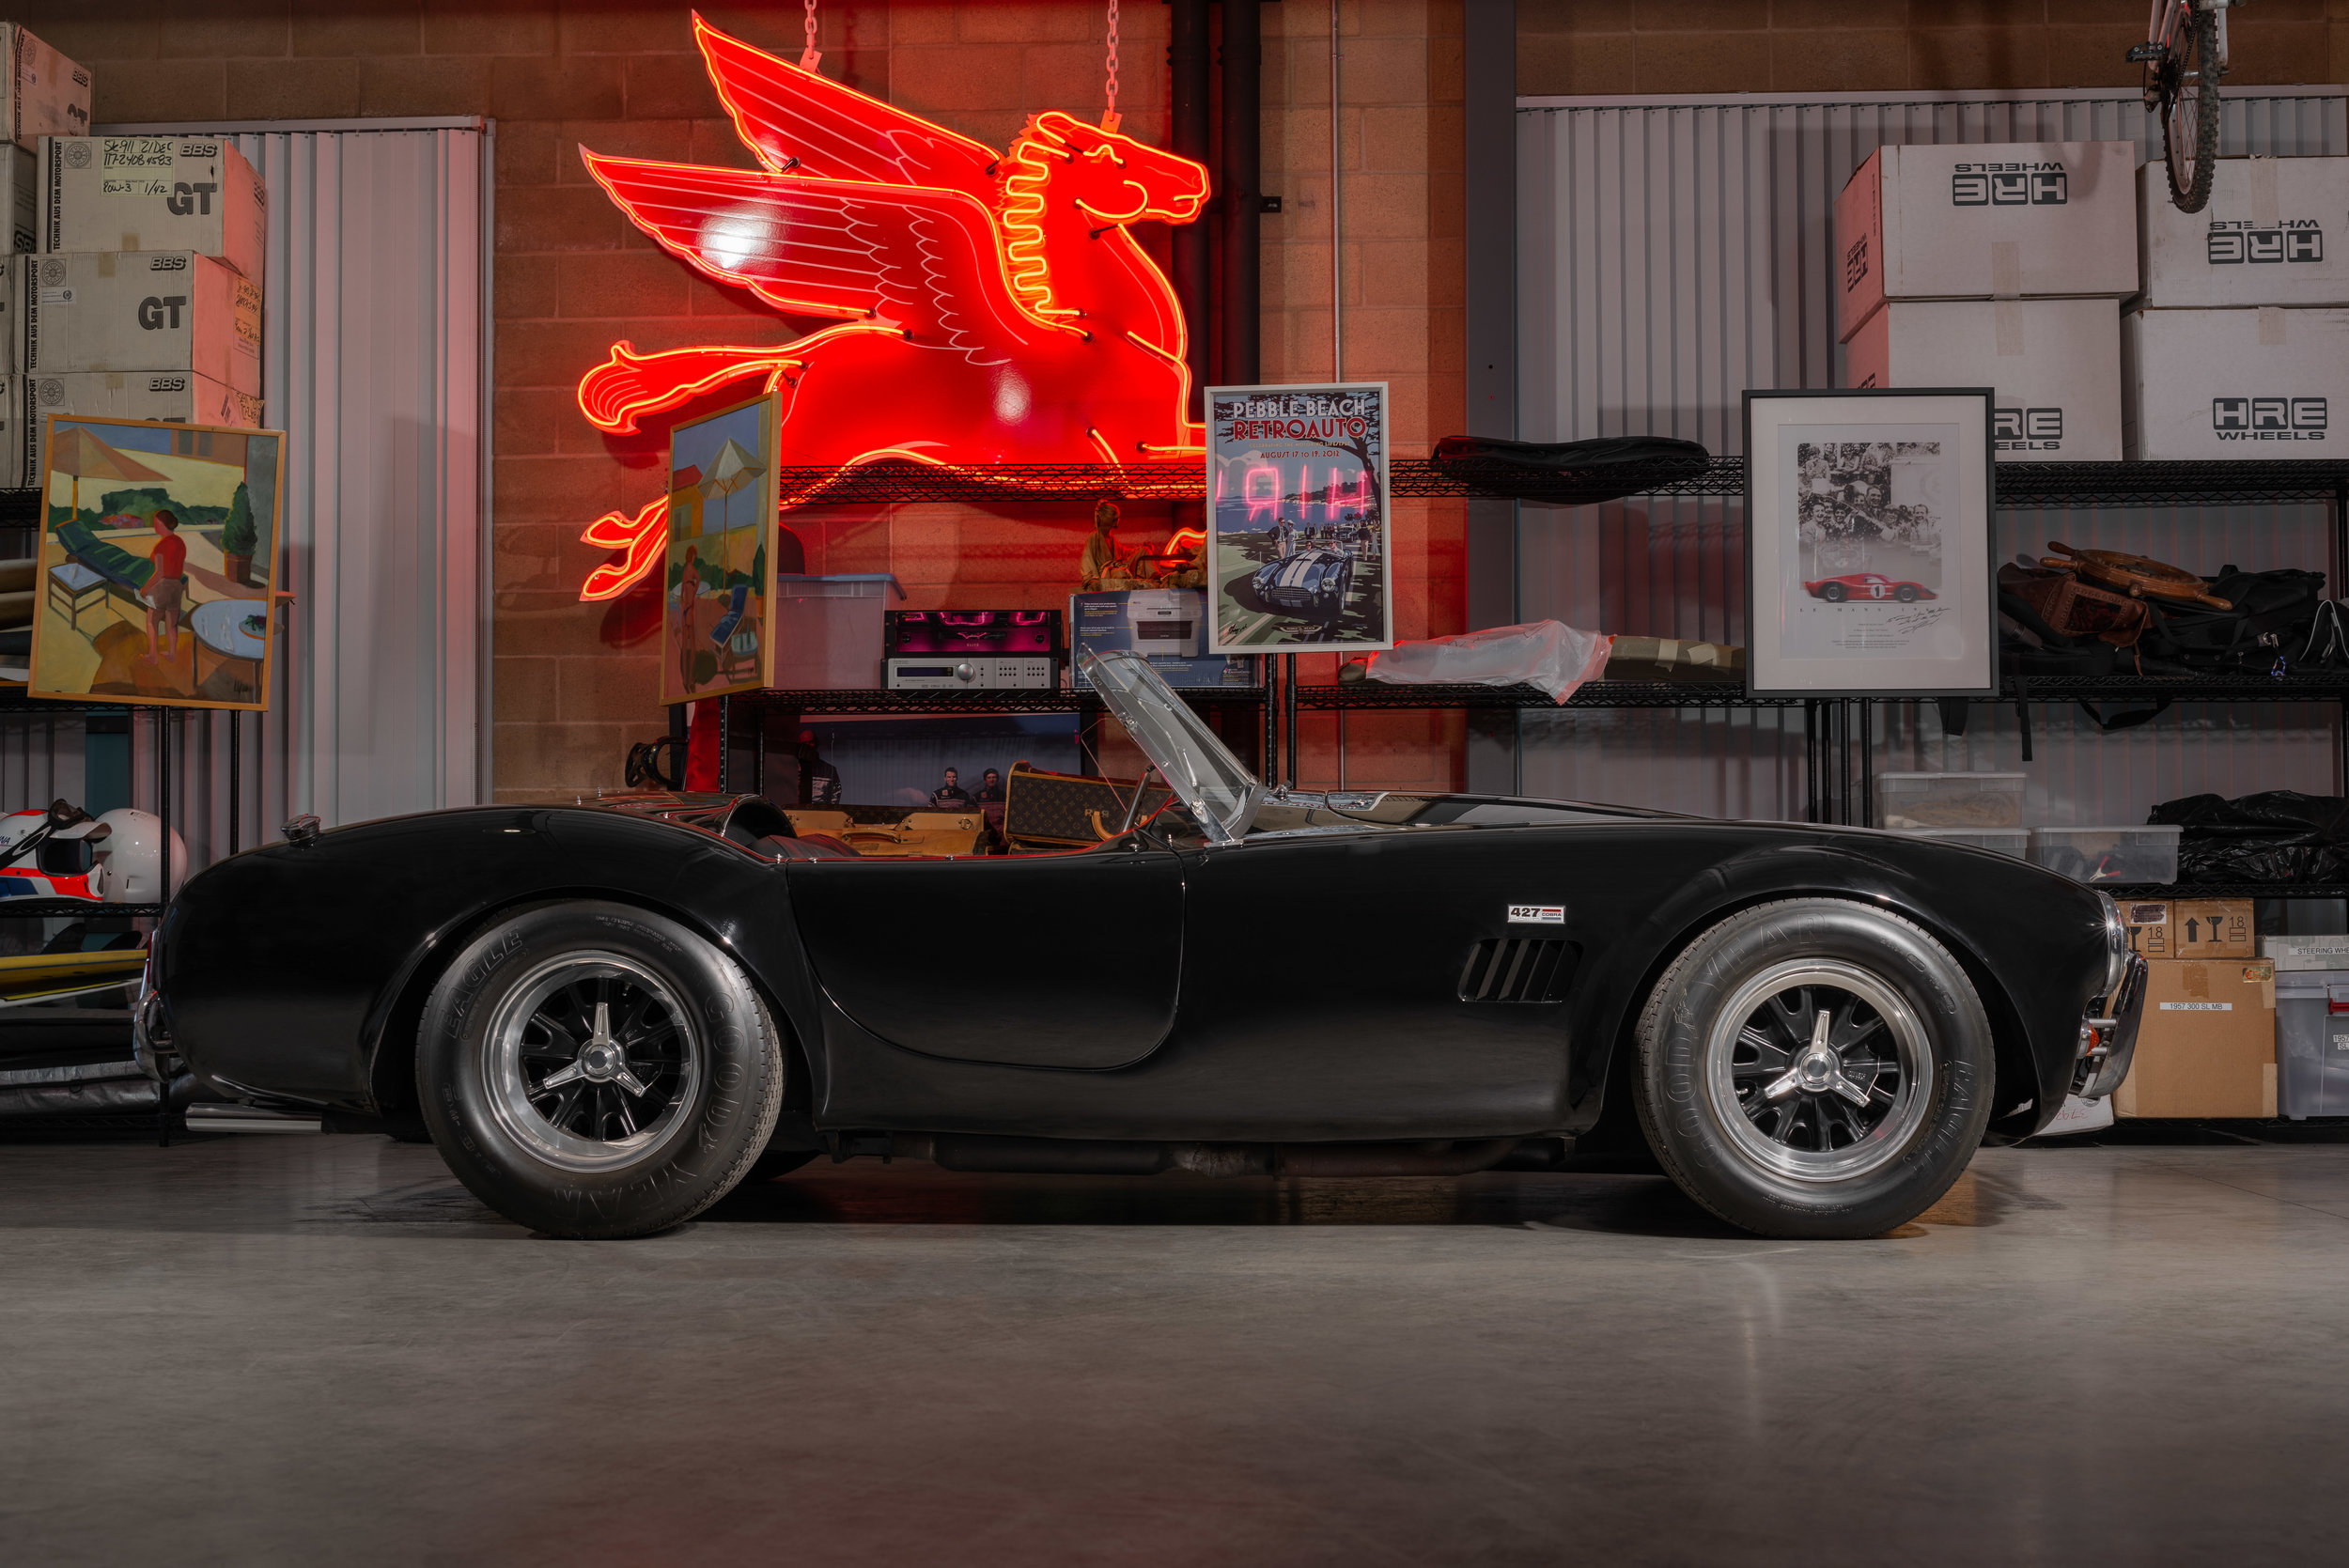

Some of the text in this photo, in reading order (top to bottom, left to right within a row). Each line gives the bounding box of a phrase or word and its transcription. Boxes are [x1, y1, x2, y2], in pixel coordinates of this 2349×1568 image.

[179, 144, 218, 158] BBS
[1954, 163, 2064, 172] WHEELS
[1952, 173, 2067, 206] HRE
[166, 181, 218, 216] GT
[2209, 219, 2320, 230] WHELS
[2207, 230, 2324, 264] HRE
[150, 256, 186, 271] BBS
[138, 296, 186, 331] GT
[148, 378, 185, 392] BBS
[1233, 398, 1365, 419] PEBBLE BEACH
[2212, 397, 2327, 430] HRE
[1233, 417, 1367, 441] RETROAUTO
[1995, 408, 2062, 440] RE
[2217, 430, 2326, 441] WHEELS
[1995, 442, 2061, 450] EELS
[1510, 908, 1541, 918] 427
[2229, 916, 2245, 927] 18
[2148, 926, 2163, 938] 18
[437, 924, 524, 1039] EAGLE
